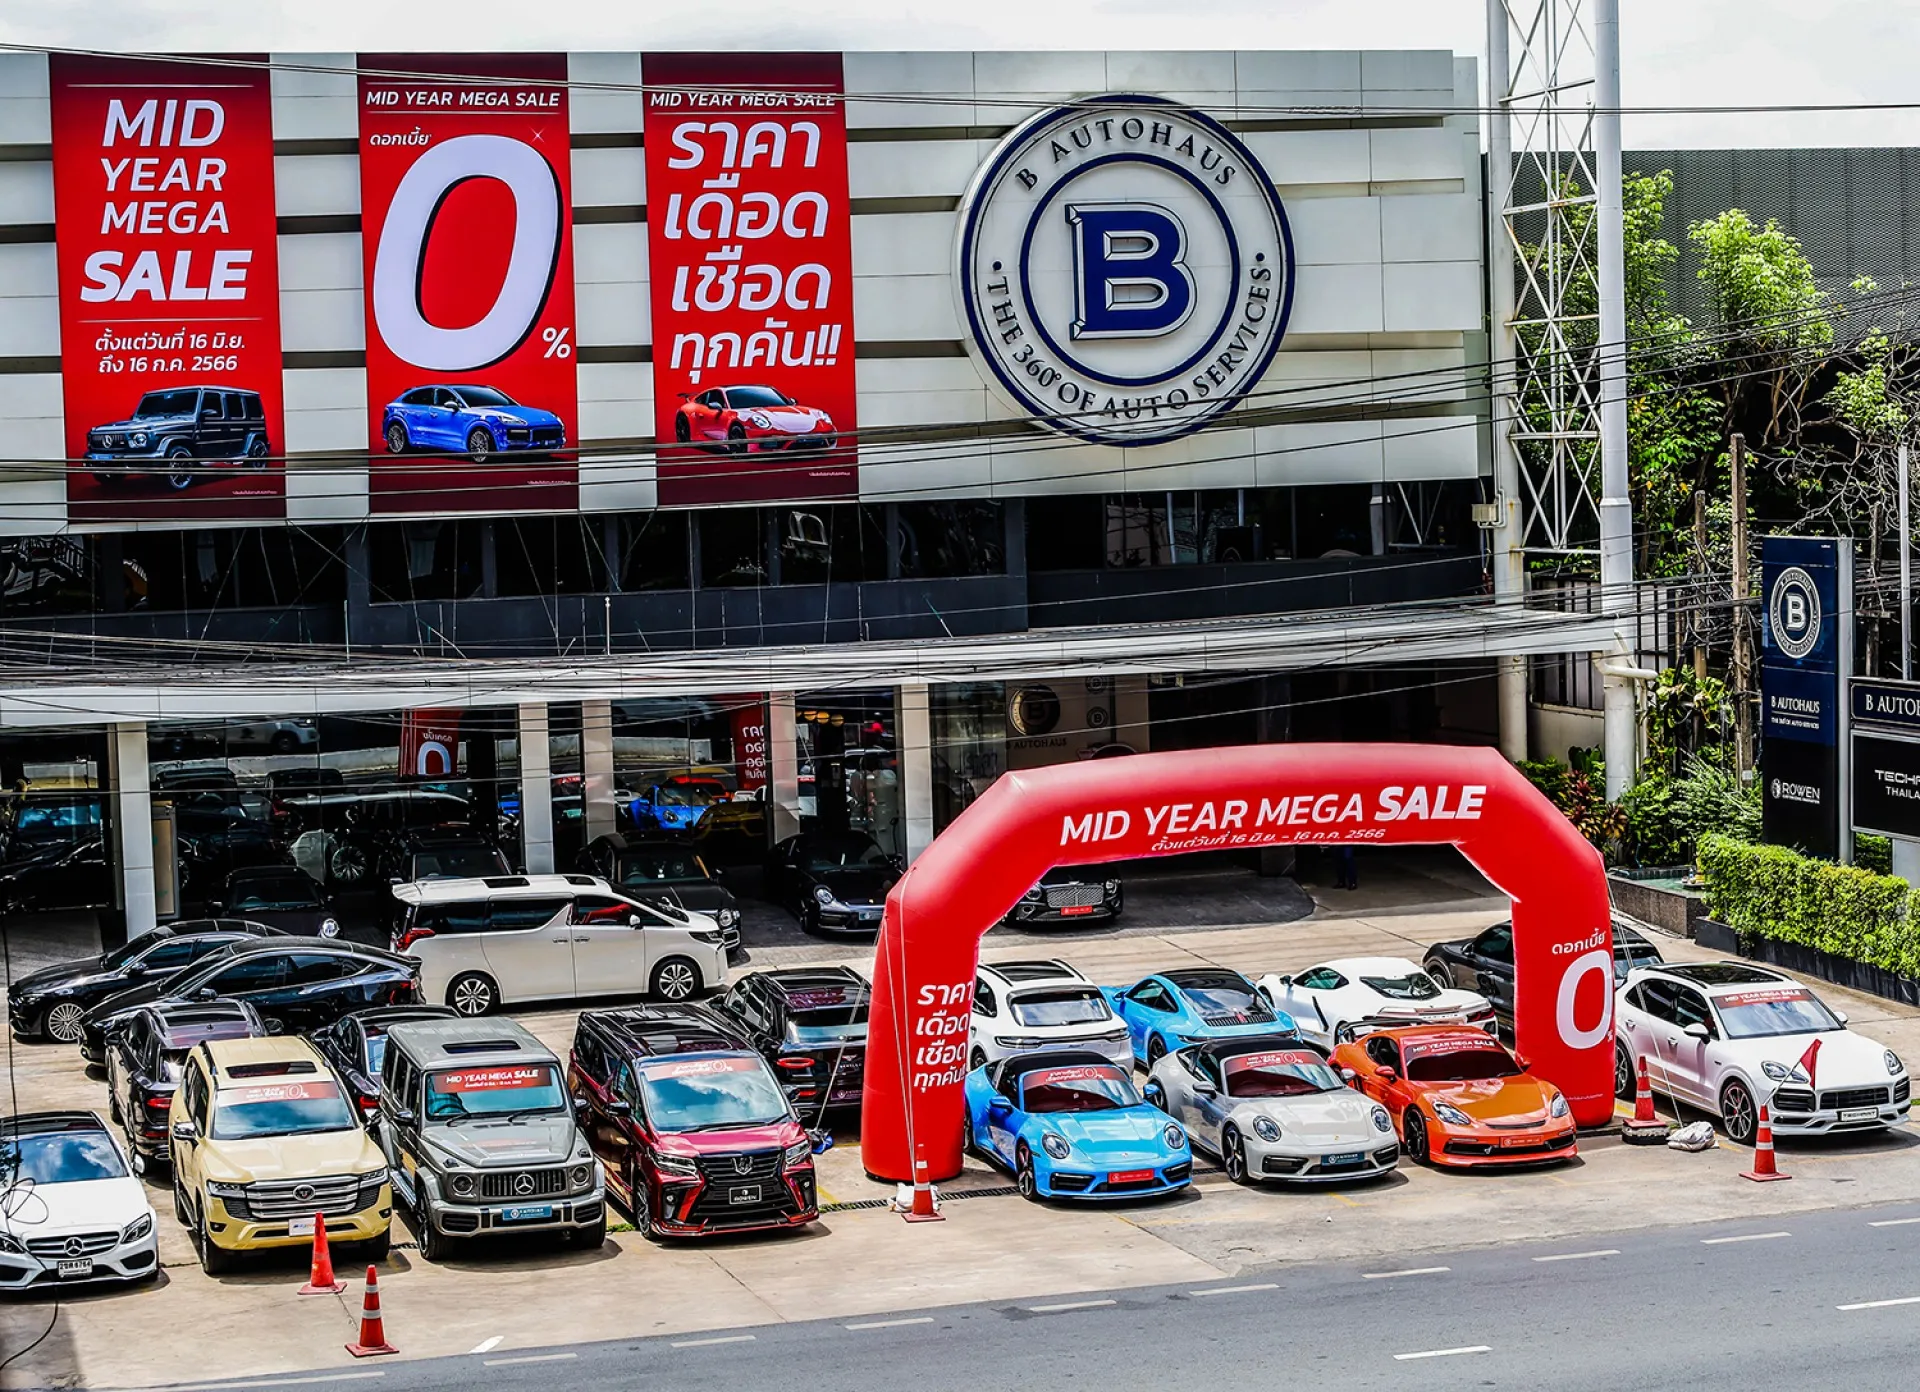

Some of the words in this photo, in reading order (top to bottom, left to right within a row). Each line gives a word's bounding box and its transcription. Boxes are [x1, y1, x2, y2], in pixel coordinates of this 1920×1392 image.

[365, 91, 399, 105] MID
[405, 91, 453, 106] YEAR
[459, 92, 510, 106] MEGA
[515, 92, 560, 107] SALE
[650, 93, 682, 107] MID
[687, 93, 733, 107] YEAR
[739, 94, 789, 107] MEGA
[793, 94, 837, 107] SALE
[102, 99, 225, 147] MID
[370, 126, 431, 146] ดอกเบี้ย
[667, 121, 821, 170] ราคา
[1015, 168, 1038, 191] B
[1050, 118, 1236, 186] AUTOHAUS
[101, 158, 227, 192] YEAR
[101, 201, 230, 235] MEGA
[664, 172, 829, 240] เดือด
[80, 250, 253, 303] SALE
[671, 245, 832, 312] เชือด
[1065, 202, 1197, 341] B
[95, 327, 186, 351] ตั้งแต่วันที่
[189, 334, 207, 349] 16
[212, 332, 245, 349] มิ.ย.
[670, 317, 842, 384] ทุกคัน!!
[987, 276, 1024, 345] THE
[1058, 382, 1096, 412] OF
[1102, 388, 1190, 419] AUTO
[1192, 265, 1272, 398] SERVICES
[99, 354, 125, 373] ถึง
[129, 356, 148, 372] 16
[152, 357, 186, 372] ก.ค.
[192, 355, 238, 372] 2566
[1786, 592, 1806, 631] B
[1771, 695, 1776, 708] B
[1778, 697, 1820, 714] AUTOHAUS
[1865, 694, 1874, 711] B
[1014, 738, 1067, 749] AUTOHAUS
[1782, 782, 1820, 800] ROWEN
[1059, 809, 1131, 846] MID
[1145, 799, 1249, 836] YEAR
[1254, 793, 1365, 828] MEGA
[1374, 785, 1487, 821] SALE
[1151, 831, 1230, 851] ตั้งแต่วันที่
[1230, 833, 1247, 844] 16
[1294, 831, 1311, 841] 16
[1312, 831, 1341, 841] ก.ค.
[1344, 828, 1386, 839] 2566
[917, 980, 974, 1006] ราคา
[915, 1009, 969, 1036] เดือด
[916, 1039, 967, 1066] เชือด
[446, 1075, 462, 1085] MID
[464, 1074, 487, 1082] YEAR
[488, 1072, 513, 1081] MEGA
[513, 1069, 539, 1078] SALE
